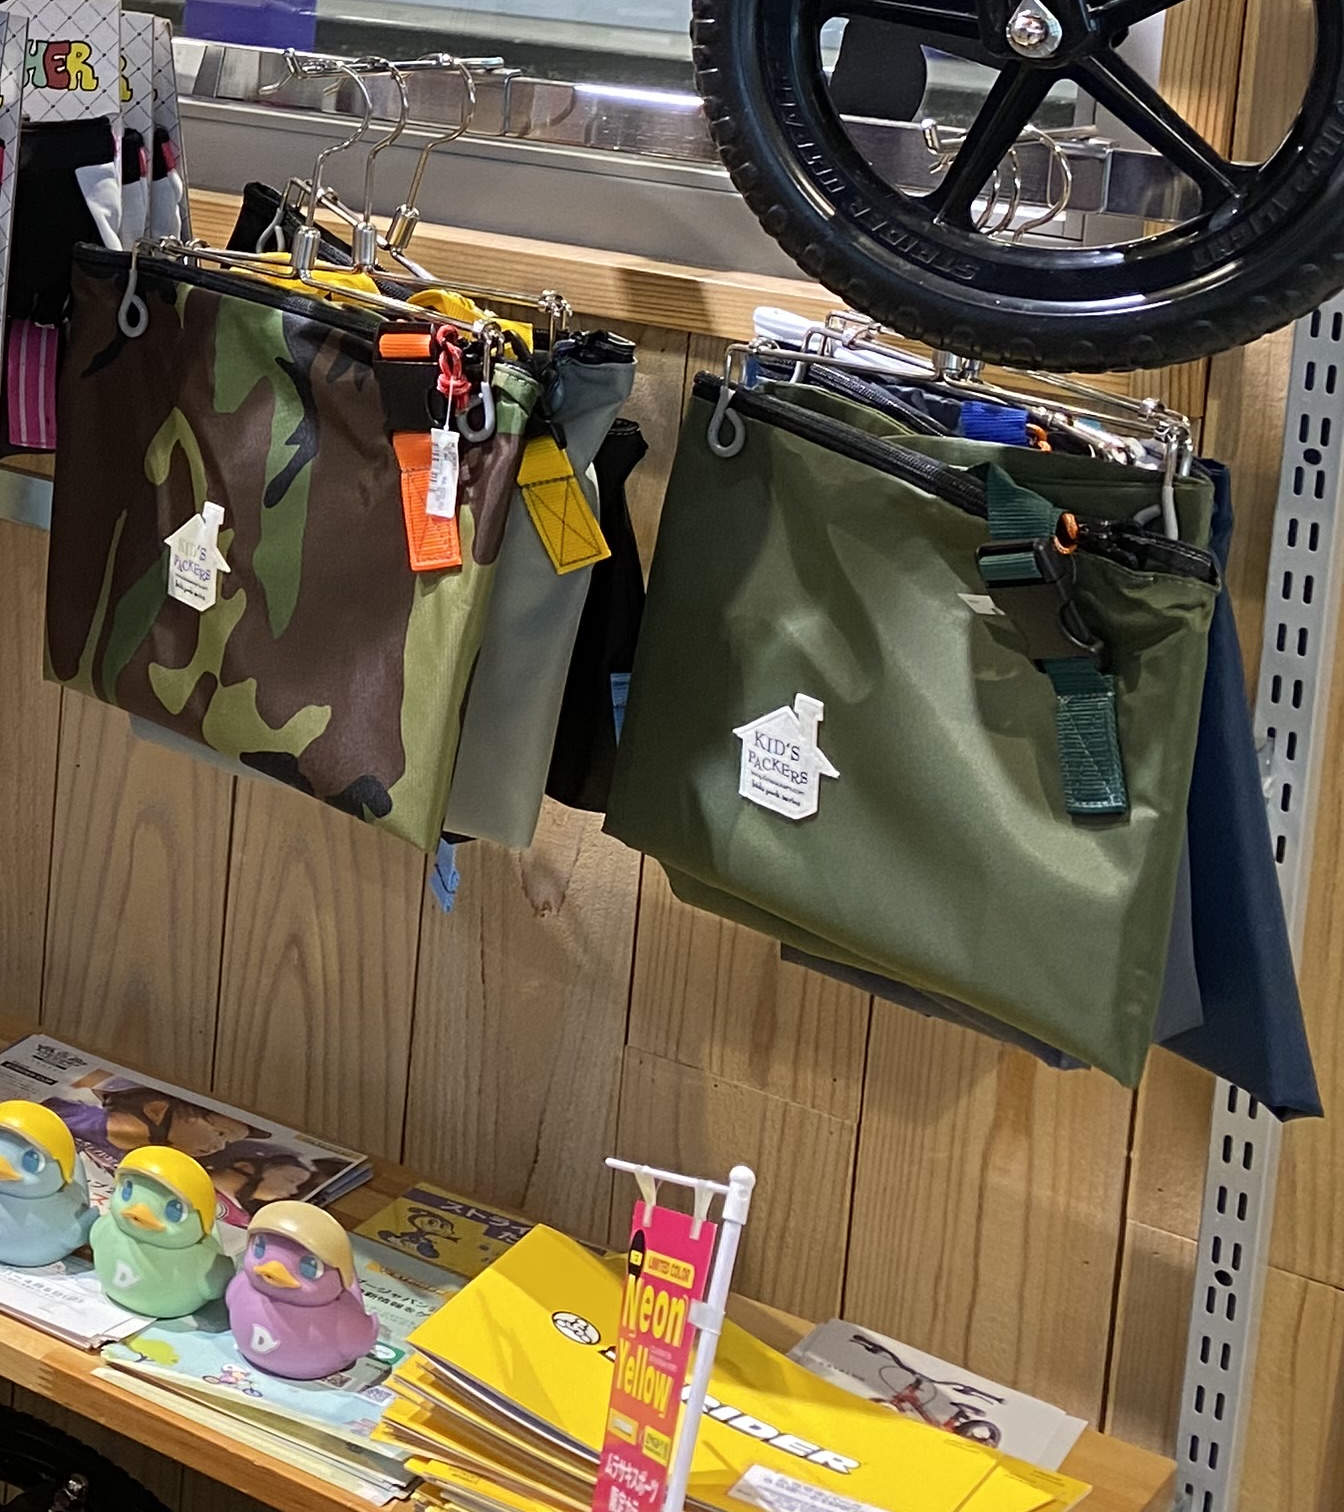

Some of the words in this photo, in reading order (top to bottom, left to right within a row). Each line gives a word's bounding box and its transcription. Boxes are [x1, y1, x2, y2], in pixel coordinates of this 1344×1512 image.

[753, 730, 801, 762] KID'S
[748, 749, 809, 785] PACKERS
[441, 1200, 530, 1236] ストライ
[669, 1262, 692, 1281] COLOR
[622, 1274, 687, 1348] Neon
[615, 1338, 674, 1419] Yellow
